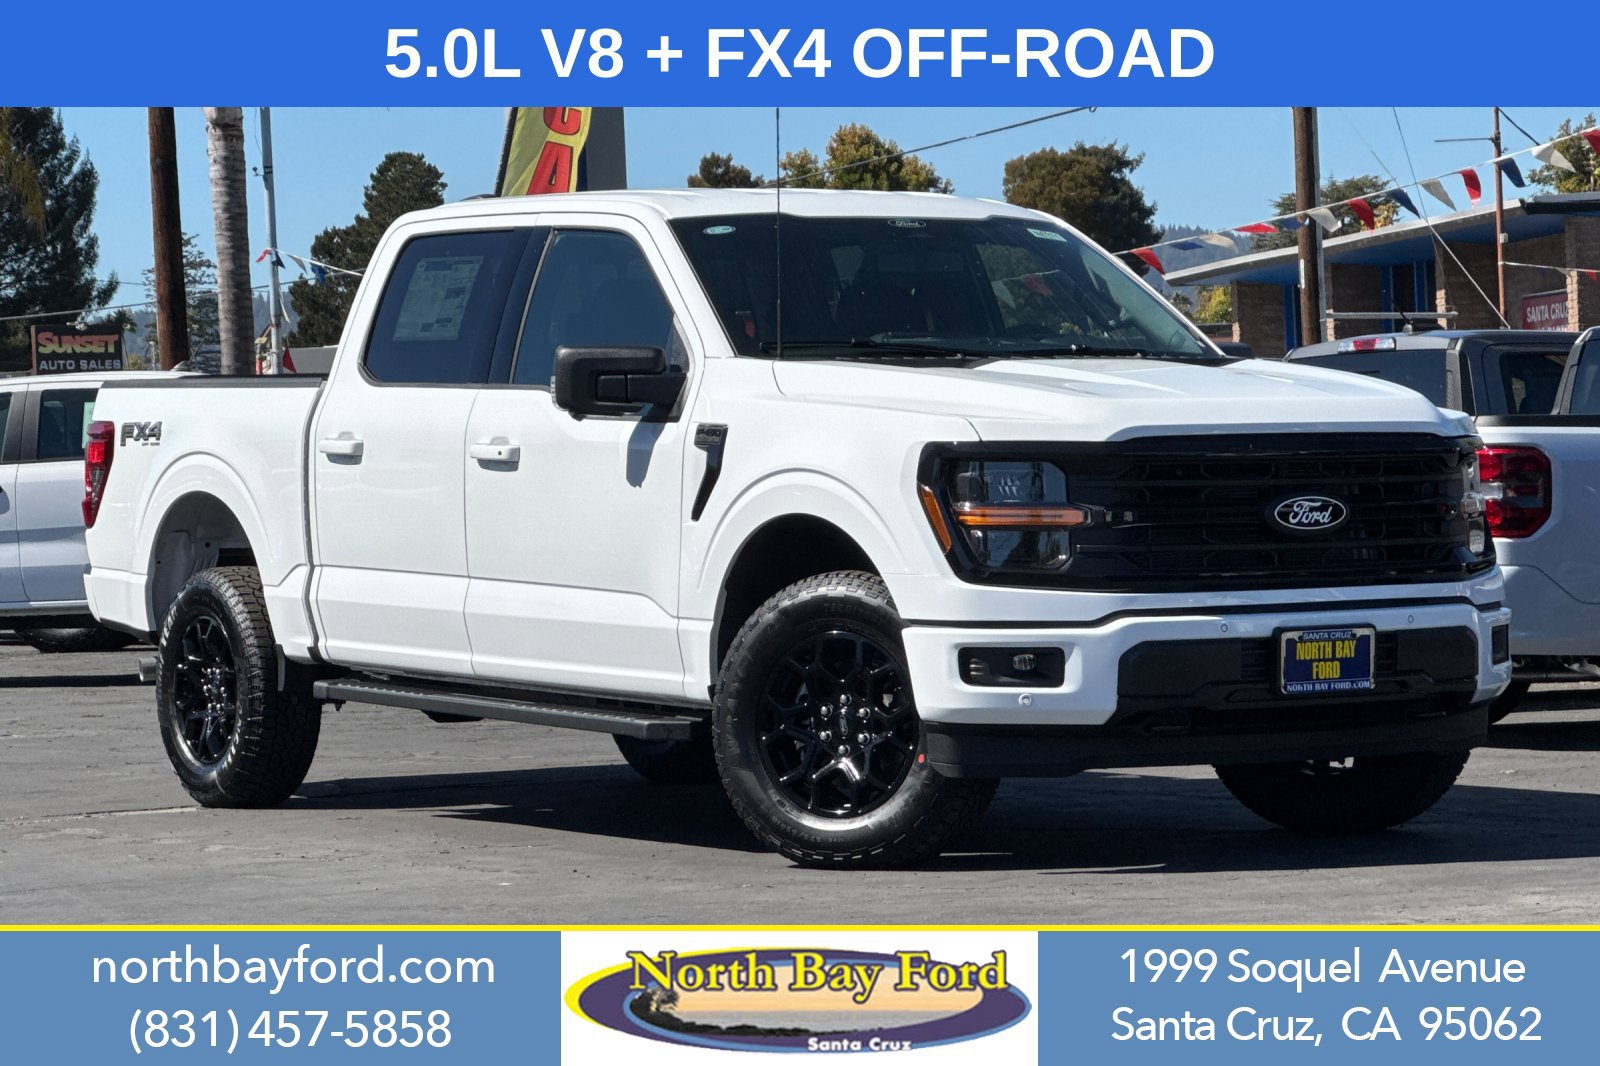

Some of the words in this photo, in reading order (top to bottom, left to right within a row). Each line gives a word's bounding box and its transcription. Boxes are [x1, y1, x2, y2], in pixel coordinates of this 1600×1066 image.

[1526, 304, 1549, 323] SANTA
[37, 331, 119, 354] SUNSET
[39, 359, 75, 370] AUTO
[80, 359, 121, 370] SALES
[120, 421, 162, 447] FX4
[1288, 500, 1333, 524] Ford
[1303, 632, 1329, 640] SANTA
[1330, 631, 1352, 639] CRUZ
[1296, 641, 1333, 660] NORTH
[1335, 639, 1356, 658] BAY
[1312, 661, 1340, 680] FORD
[1314, 682, 1330, 691] BAY
